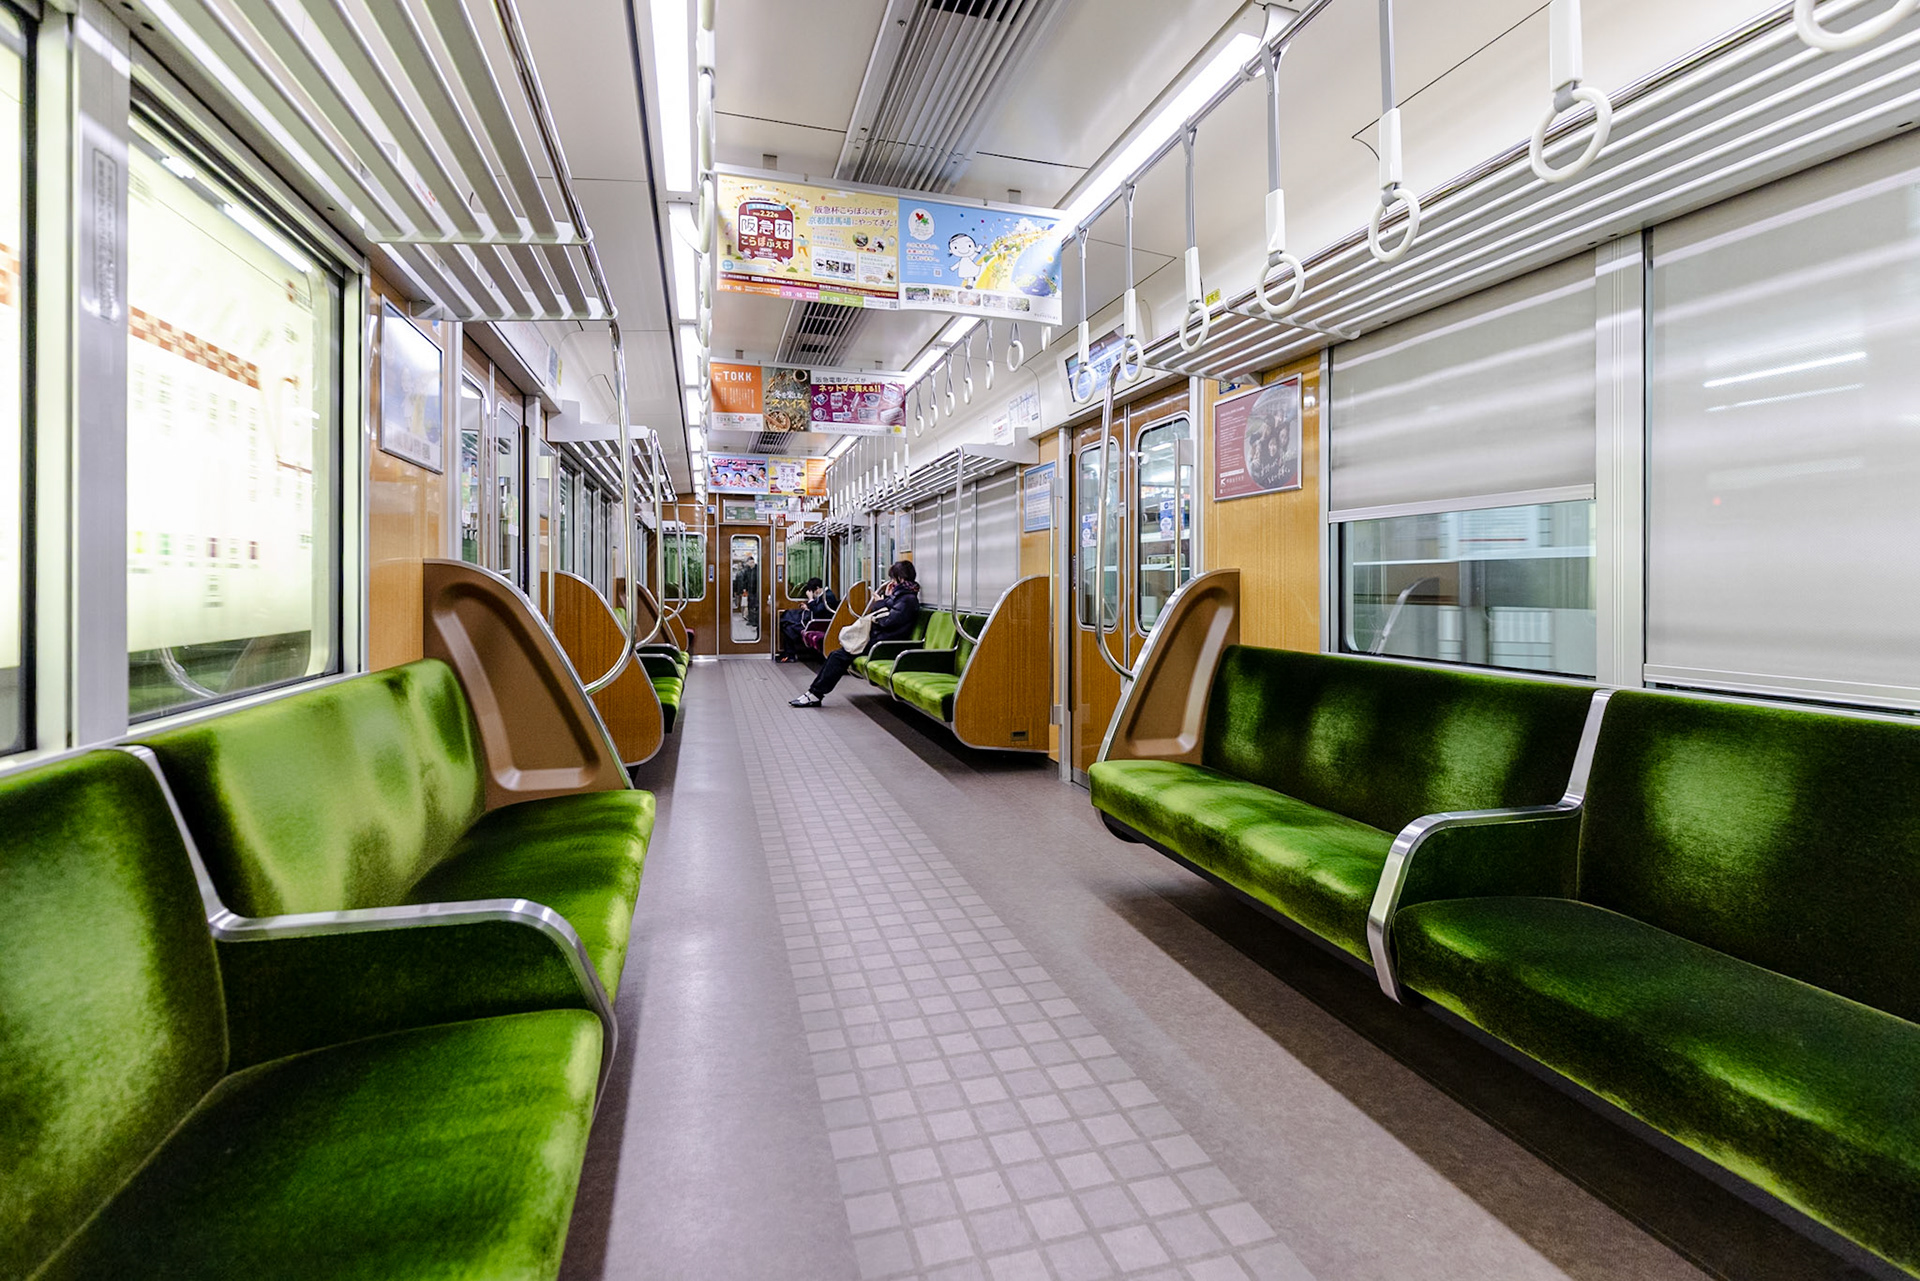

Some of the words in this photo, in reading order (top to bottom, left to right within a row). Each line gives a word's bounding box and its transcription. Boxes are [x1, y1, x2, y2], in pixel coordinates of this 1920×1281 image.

[740, 217, 792, 238] 阪急杯
[740, 235, 791, 250] こらぼふぇす
[723, 371, 752, 382] TOKK
